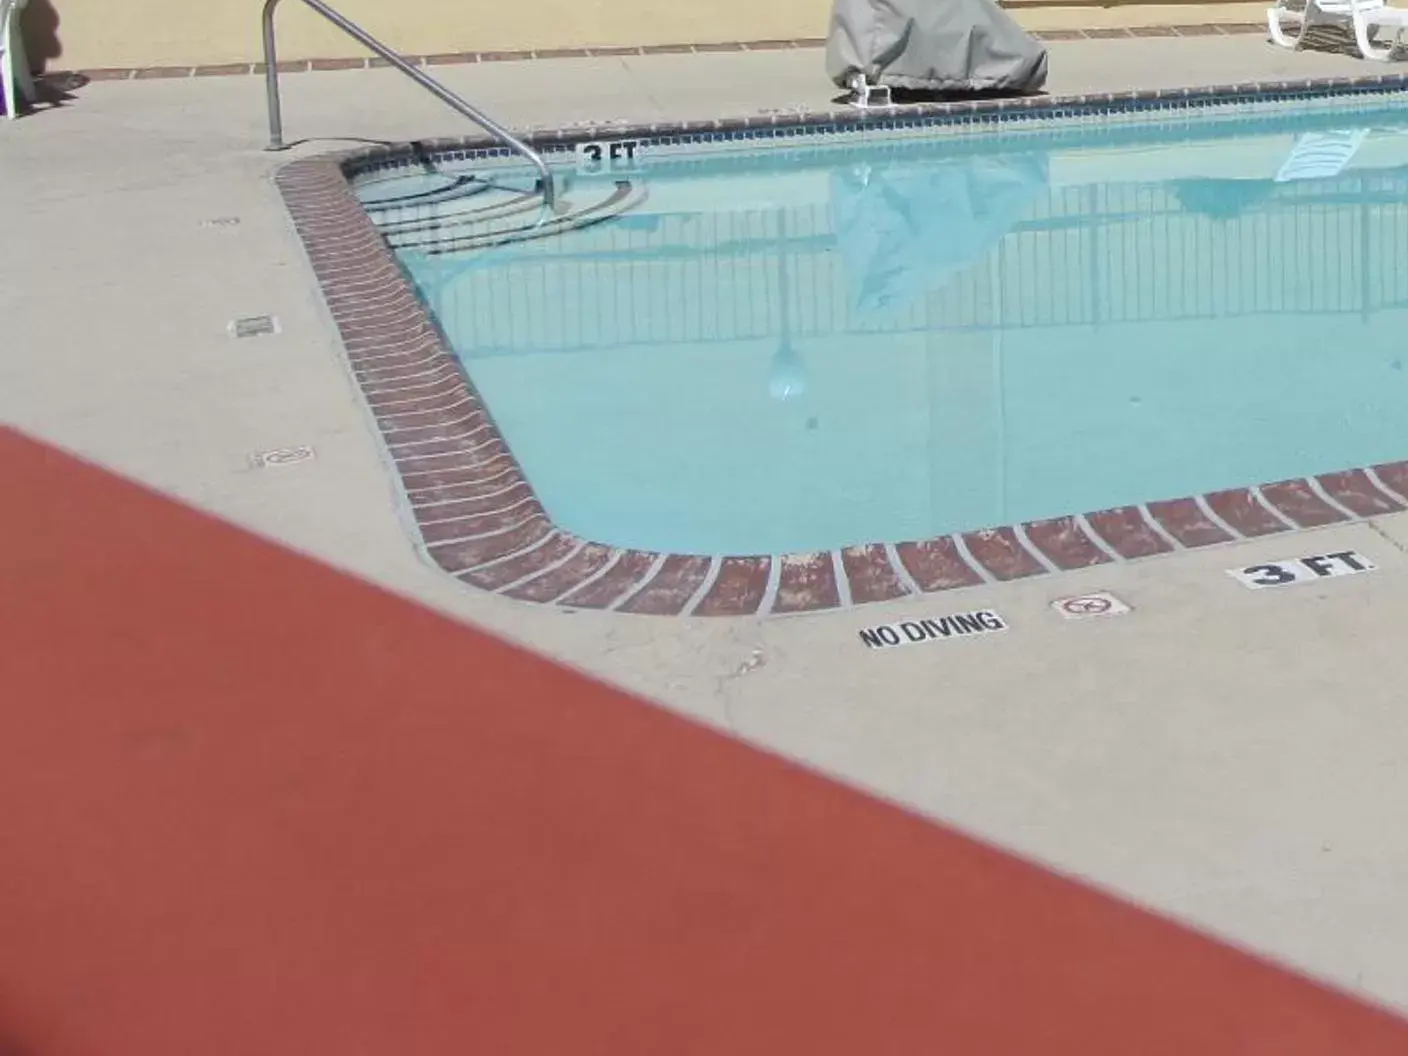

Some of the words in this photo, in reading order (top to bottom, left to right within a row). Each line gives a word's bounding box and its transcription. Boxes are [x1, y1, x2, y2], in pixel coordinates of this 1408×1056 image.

[583, 144, 602, 161] 3
[609, 141, 637, 160] FT
[1243, 564, 1296, 585] 3
[859, 625, 900, 648] NO
[900, 611, 1005, 642] DIVING
